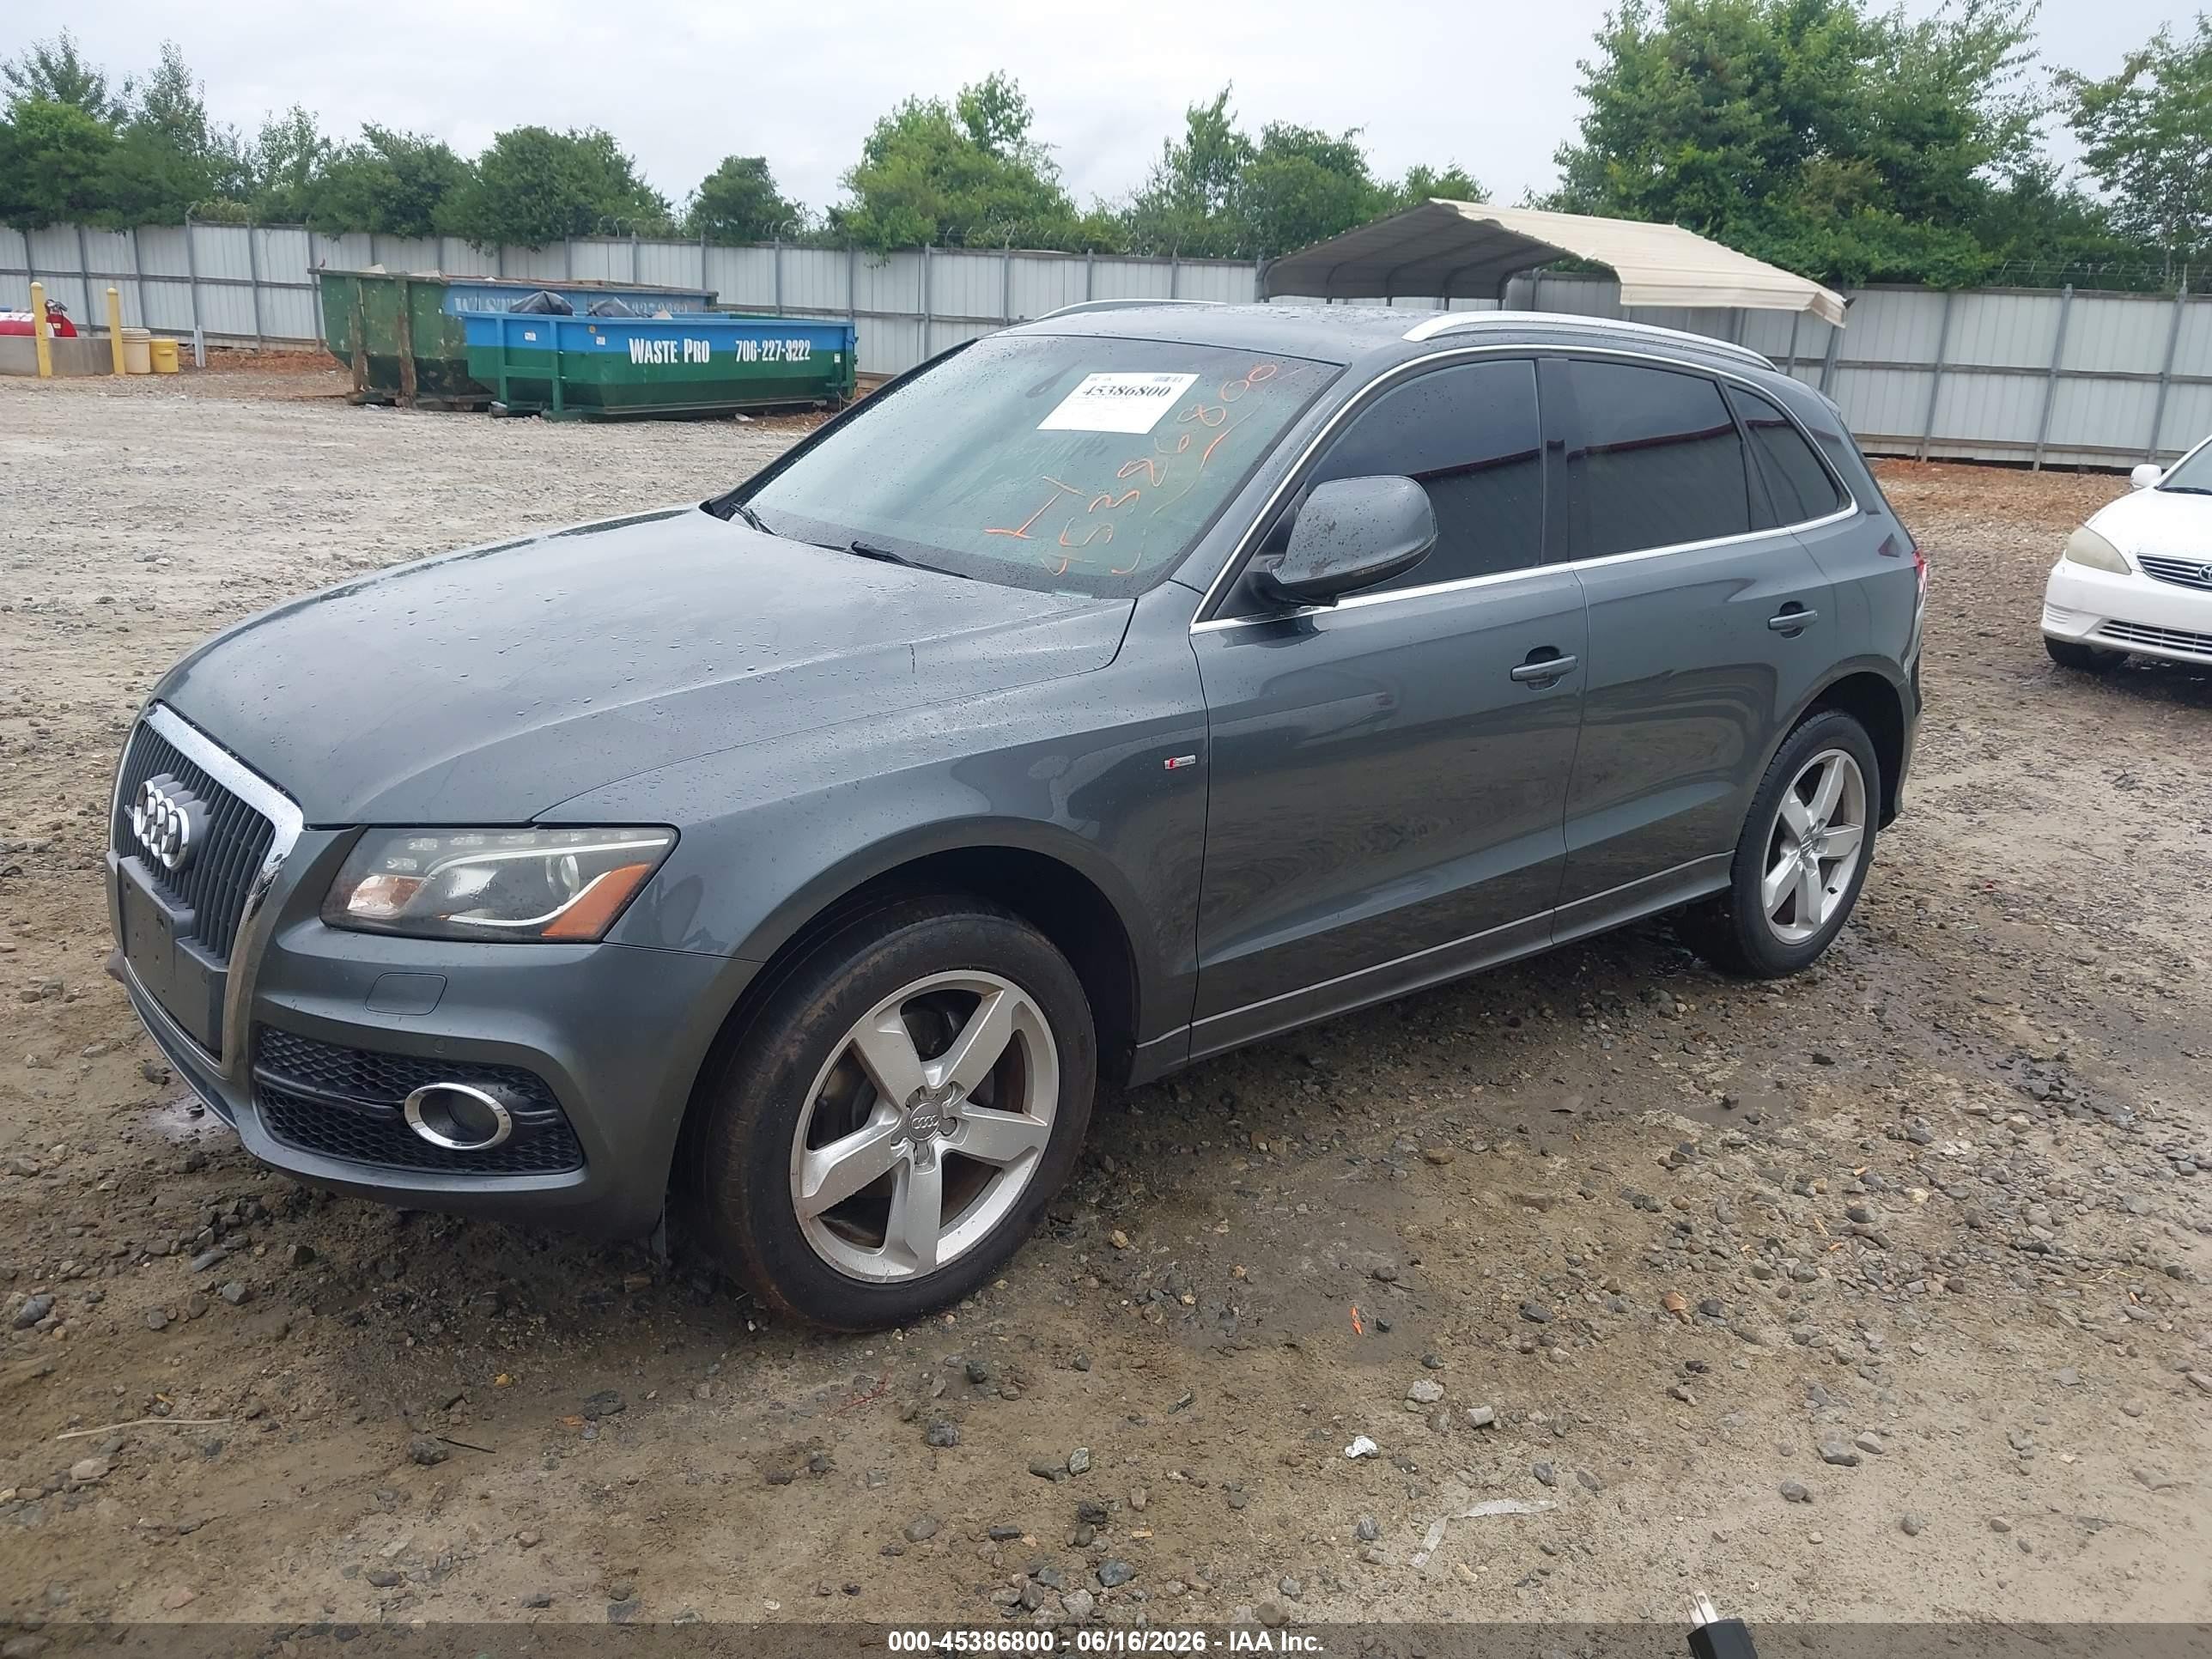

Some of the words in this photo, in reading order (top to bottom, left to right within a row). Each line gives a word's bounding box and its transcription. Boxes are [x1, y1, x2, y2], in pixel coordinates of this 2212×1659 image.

[629, 338, 678, 364] WASTE
[684, 338, 709, 363] PRO
[1082, 385, 1171, 398] 45386800
